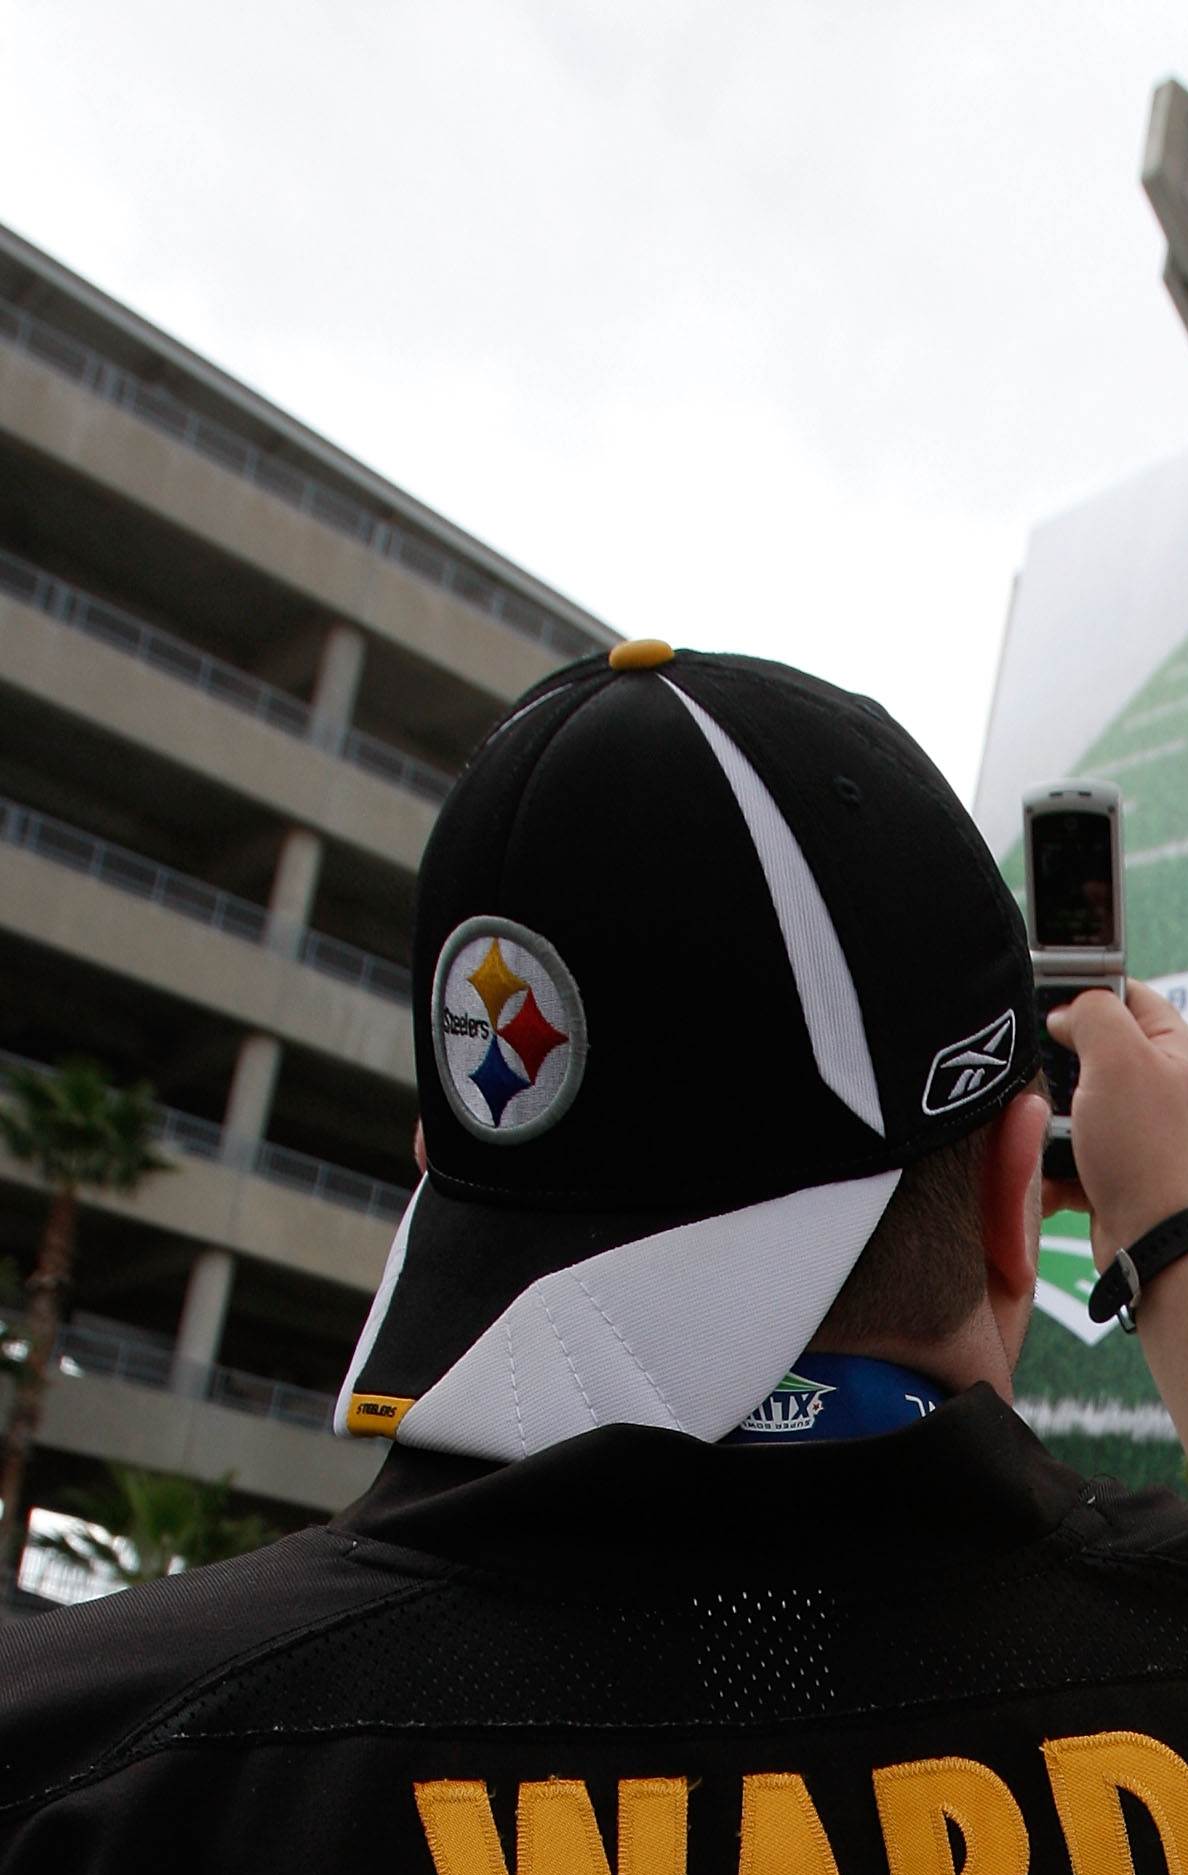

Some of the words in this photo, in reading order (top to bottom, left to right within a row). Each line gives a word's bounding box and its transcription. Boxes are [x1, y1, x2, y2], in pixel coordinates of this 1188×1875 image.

[443, 1007, 490, 1040] Steelers
[356, 1402, 398, 1418] STEELERS
[775, 1420, 810, 1430] SUPER
